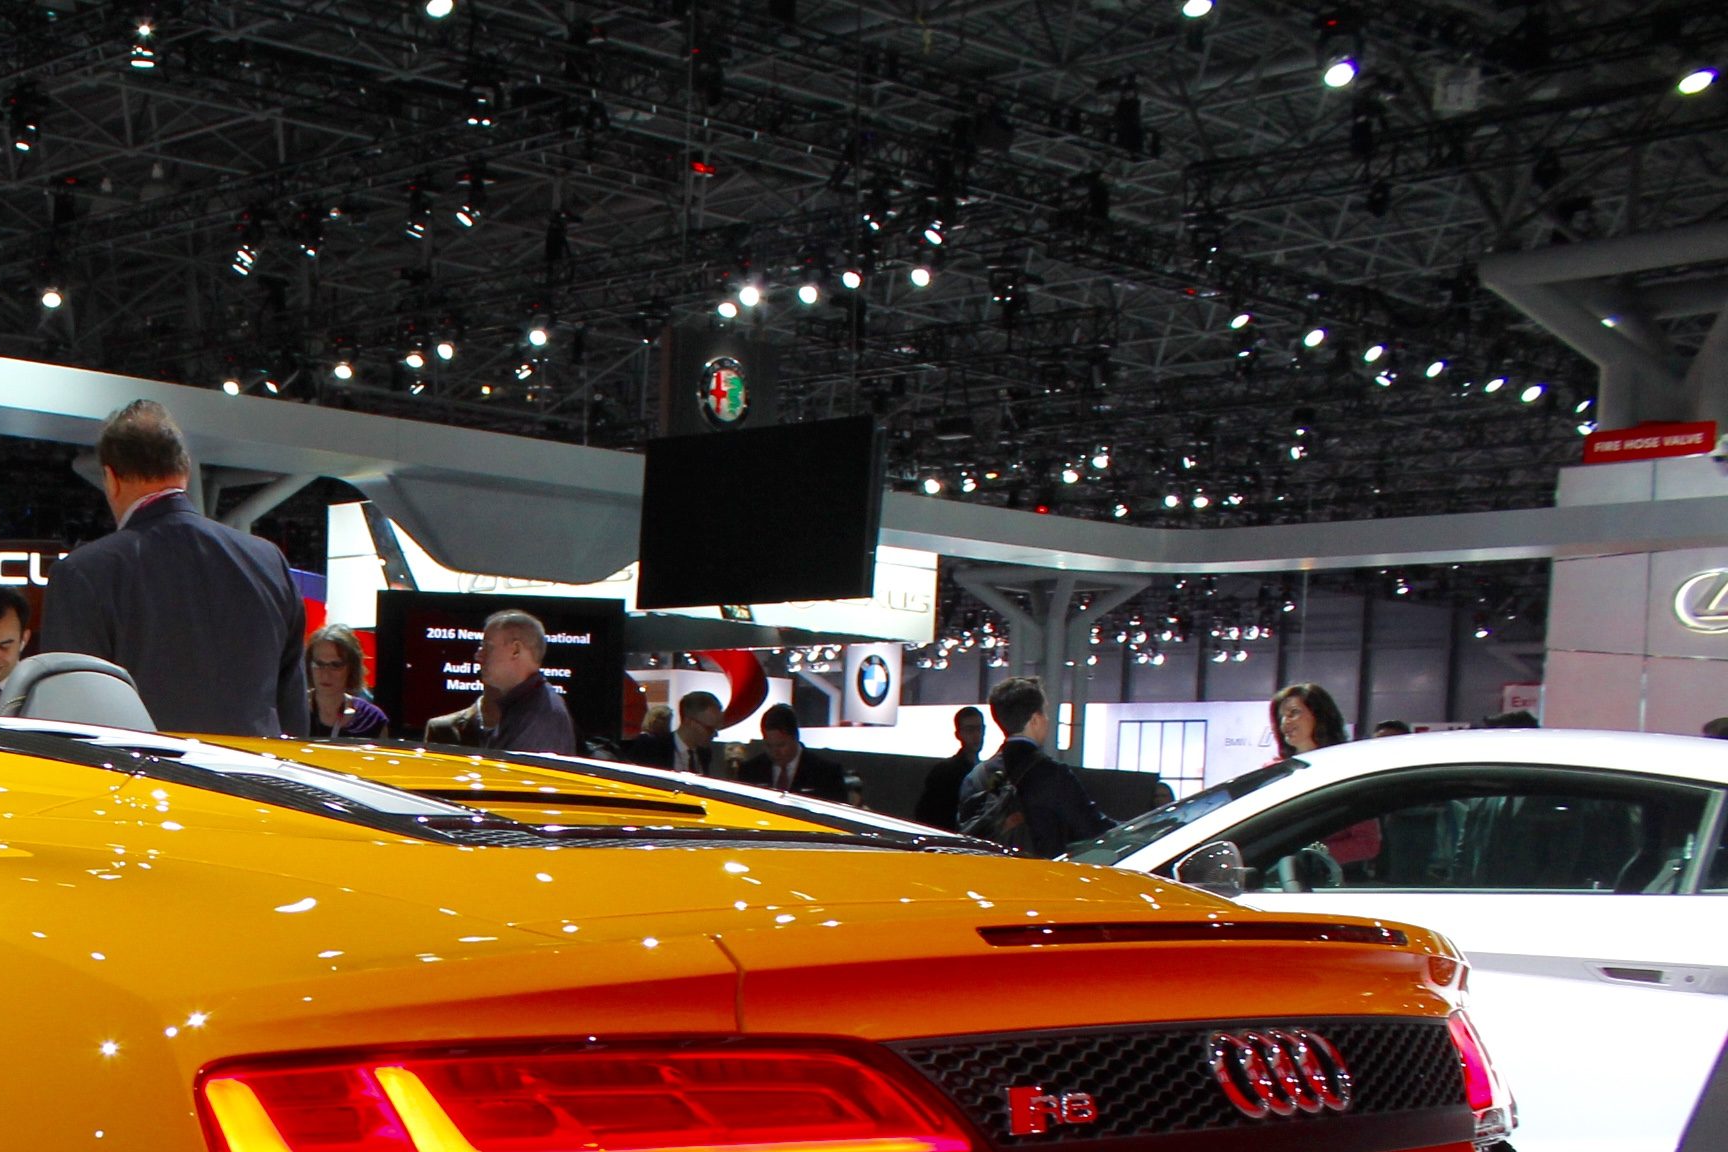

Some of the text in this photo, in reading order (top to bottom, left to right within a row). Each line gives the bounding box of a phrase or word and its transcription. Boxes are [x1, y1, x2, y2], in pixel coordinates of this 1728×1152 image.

[1594, 432, 1704, 452] FIRE HOSE VALVE
[426, 627, 591, 645] 2016 New national
[443, 662, 472, 674] Audi
[446, 679, 484, 691] March
[1019, 1089, 1100, 1129] R8
